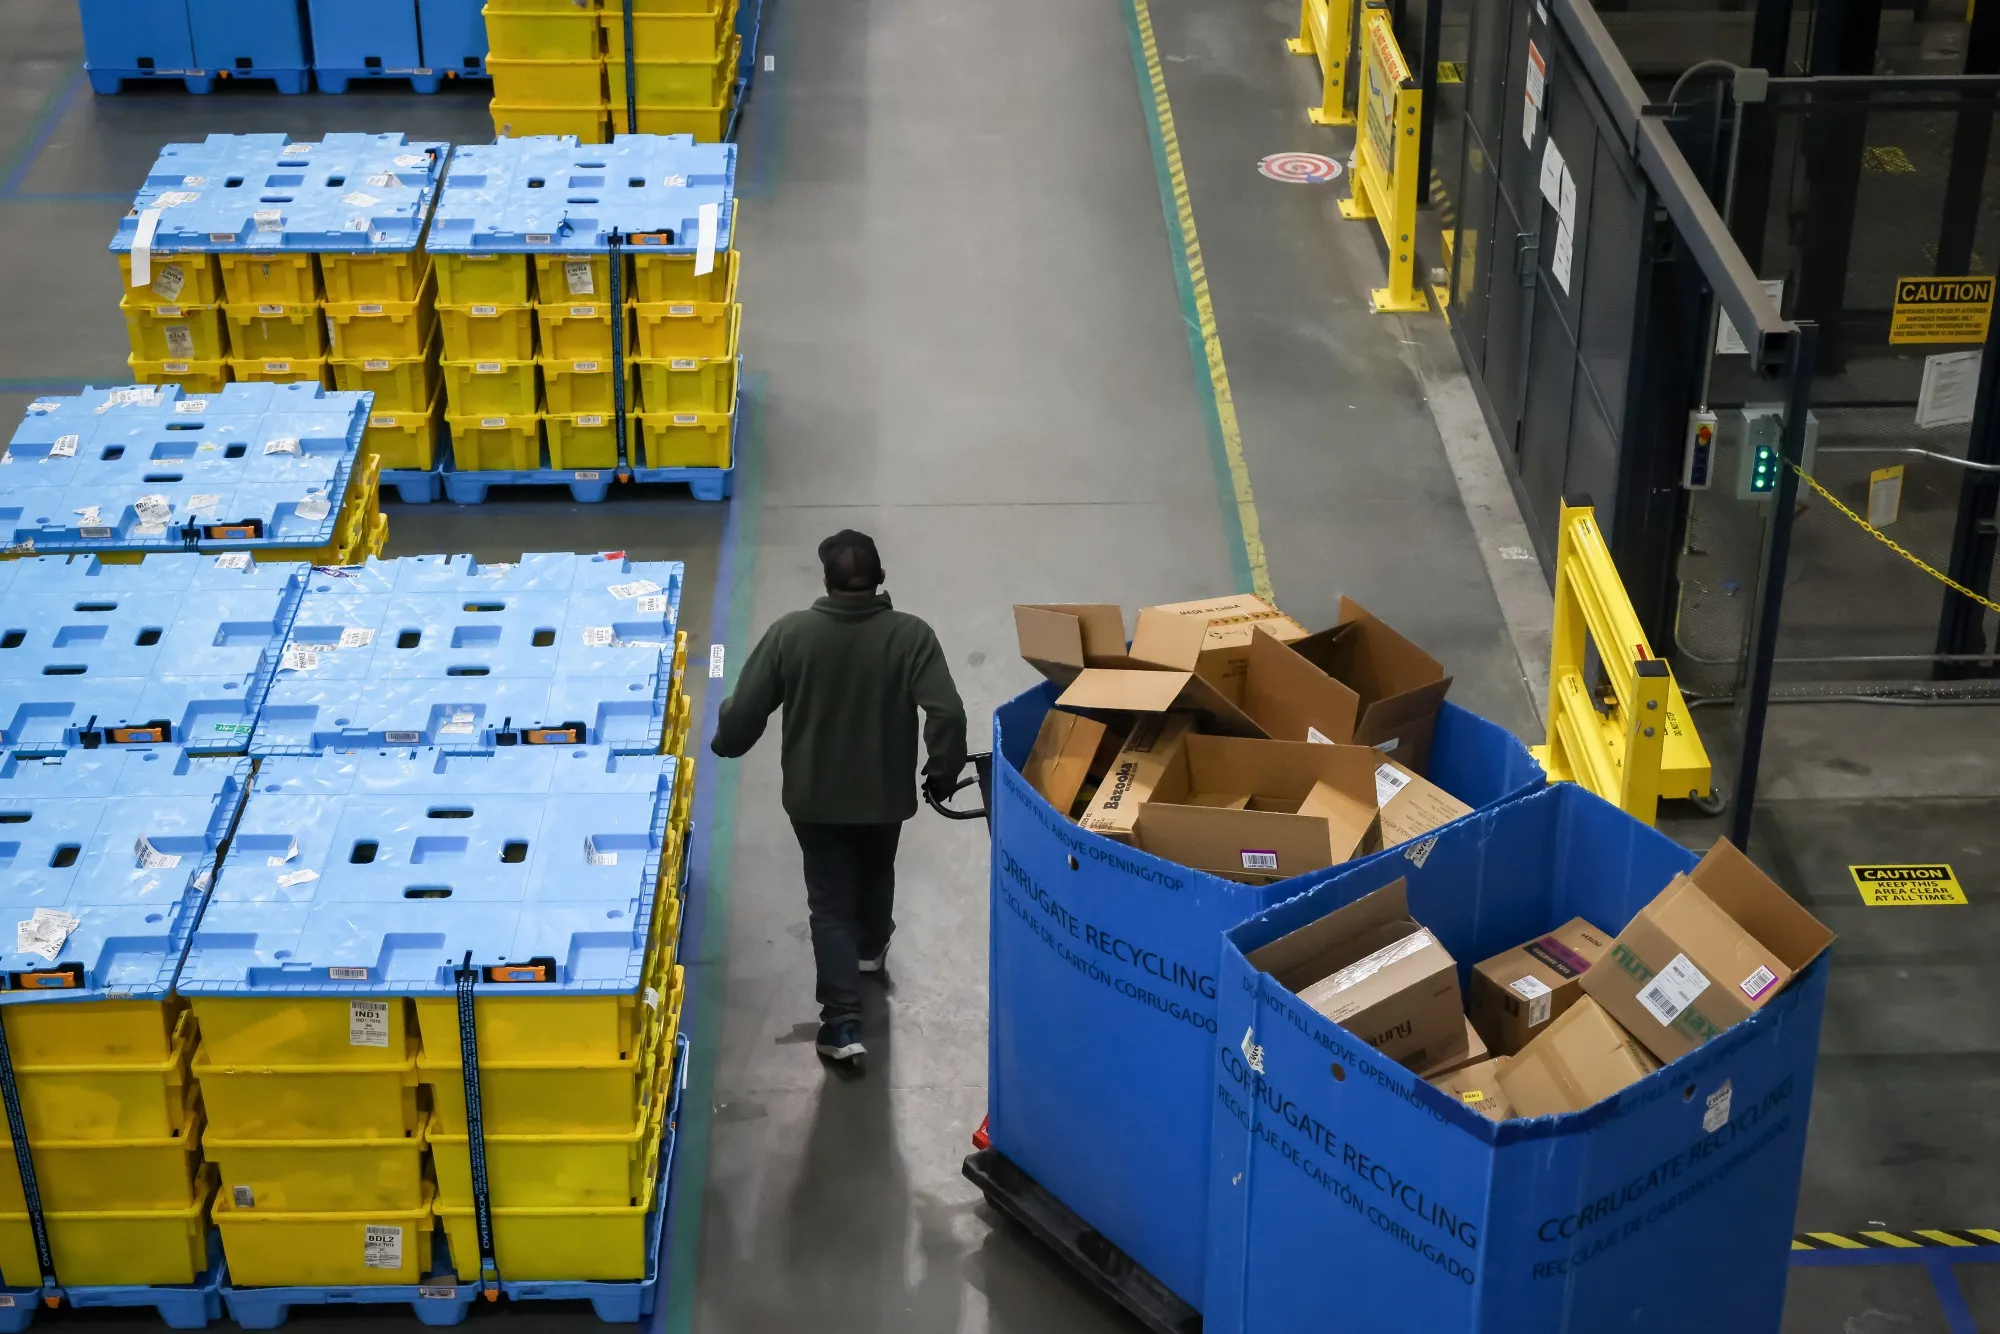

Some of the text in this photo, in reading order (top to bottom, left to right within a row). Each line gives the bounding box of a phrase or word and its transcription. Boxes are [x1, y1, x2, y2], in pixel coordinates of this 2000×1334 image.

[1901, 283, 1988, 302] CAUTION
[1216, 604, 1240, 612] CHINA
[712, 646, 722, 664] BUFFER
[1103, 762, 1133, 810] Bazooka
[1016, 787, 1034, 812] NOT
[1034, 804, 1052, 830] FILL
[1052, 826, 1087, 856] ABOVE
[1089, 846, 1184, 892] OPENING/TOP
[1864, 870, 1944, 879] CAUTION
[1000, 841, 1216, 1000] ORRUGATE RECYCLING
[1041, 926, 1056, 950] DE
[1057, 942, 1111, 987] CARTÓN
[1115, 978, 1218, 1034] CORRUGADO
[1556, 963, 1571, 974] TOYS
[355, 1010, 380, 1018] IND1
[1264, 990, 1286, 1016] NOT
[1288, 1008, 1310, 1037] FILL
[1314, 1028, 1357, 1068] ABOVE
[1369, 1020, 1412, 1047] wny
[1222, 1046, 1476, 1250] CORRUGATE RECYCLING
[1218, 1084, 1475, 1286] RECICLAJE DE CARTÓN CORRUGADO
[1537, 1154, 1686, 1243] CORRUGATE
[34, 1210, 50, 1267] OVERPACK
[478, 1194, 490, 1249] OVERPACK
